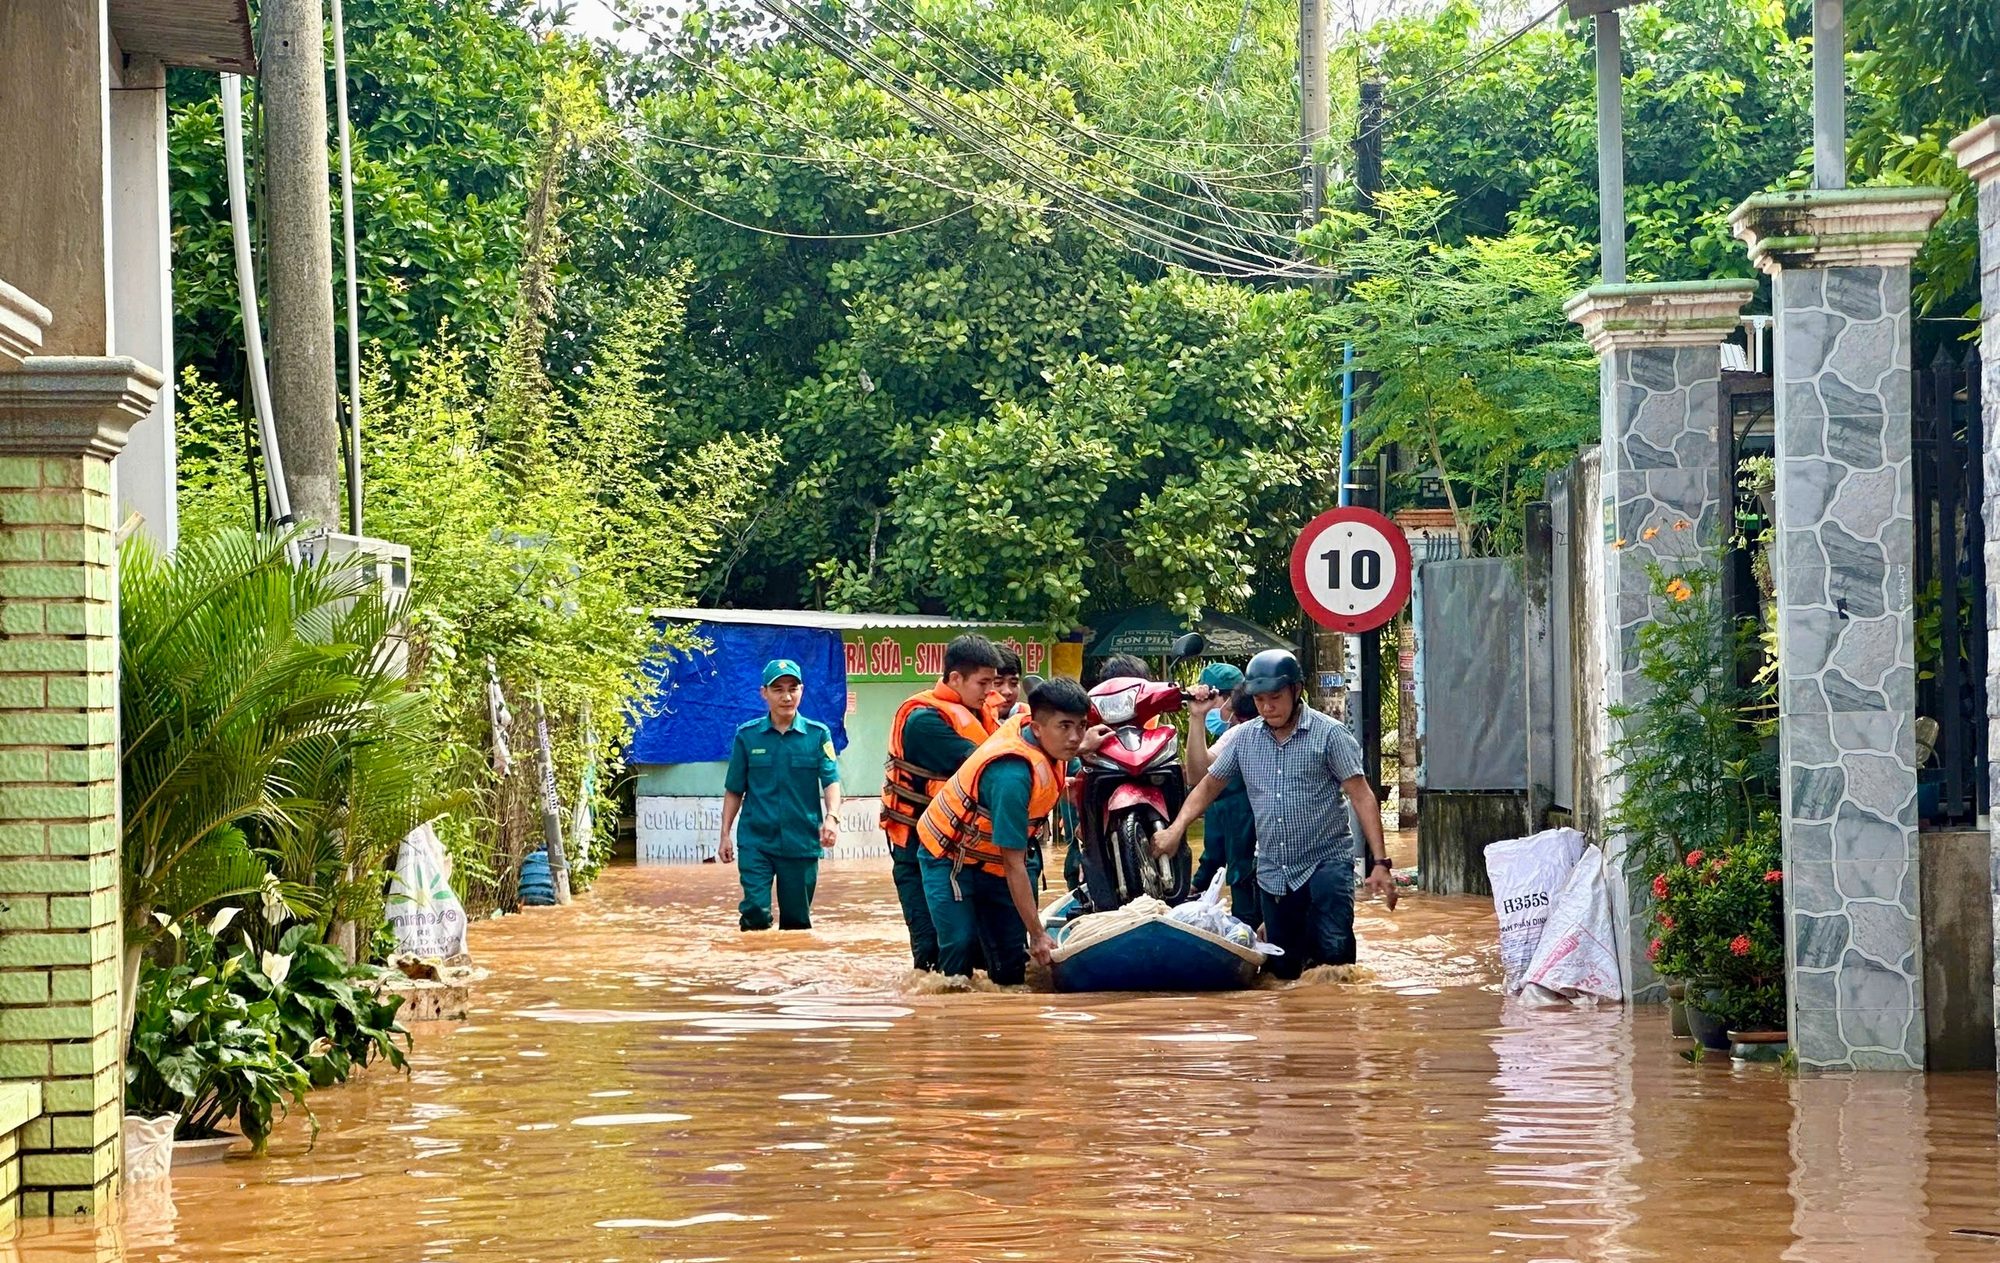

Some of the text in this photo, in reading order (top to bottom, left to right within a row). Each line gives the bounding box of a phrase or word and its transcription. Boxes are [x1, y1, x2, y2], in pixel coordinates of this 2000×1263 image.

[1320, 549, 1381, 590] 10
[843, 636, 868, 676] RÀ
[870, 636, 903, 676] SỮA
[1025, 636, 1045, 674] ÉP
[1503, 891, 1550, 914] H355S
